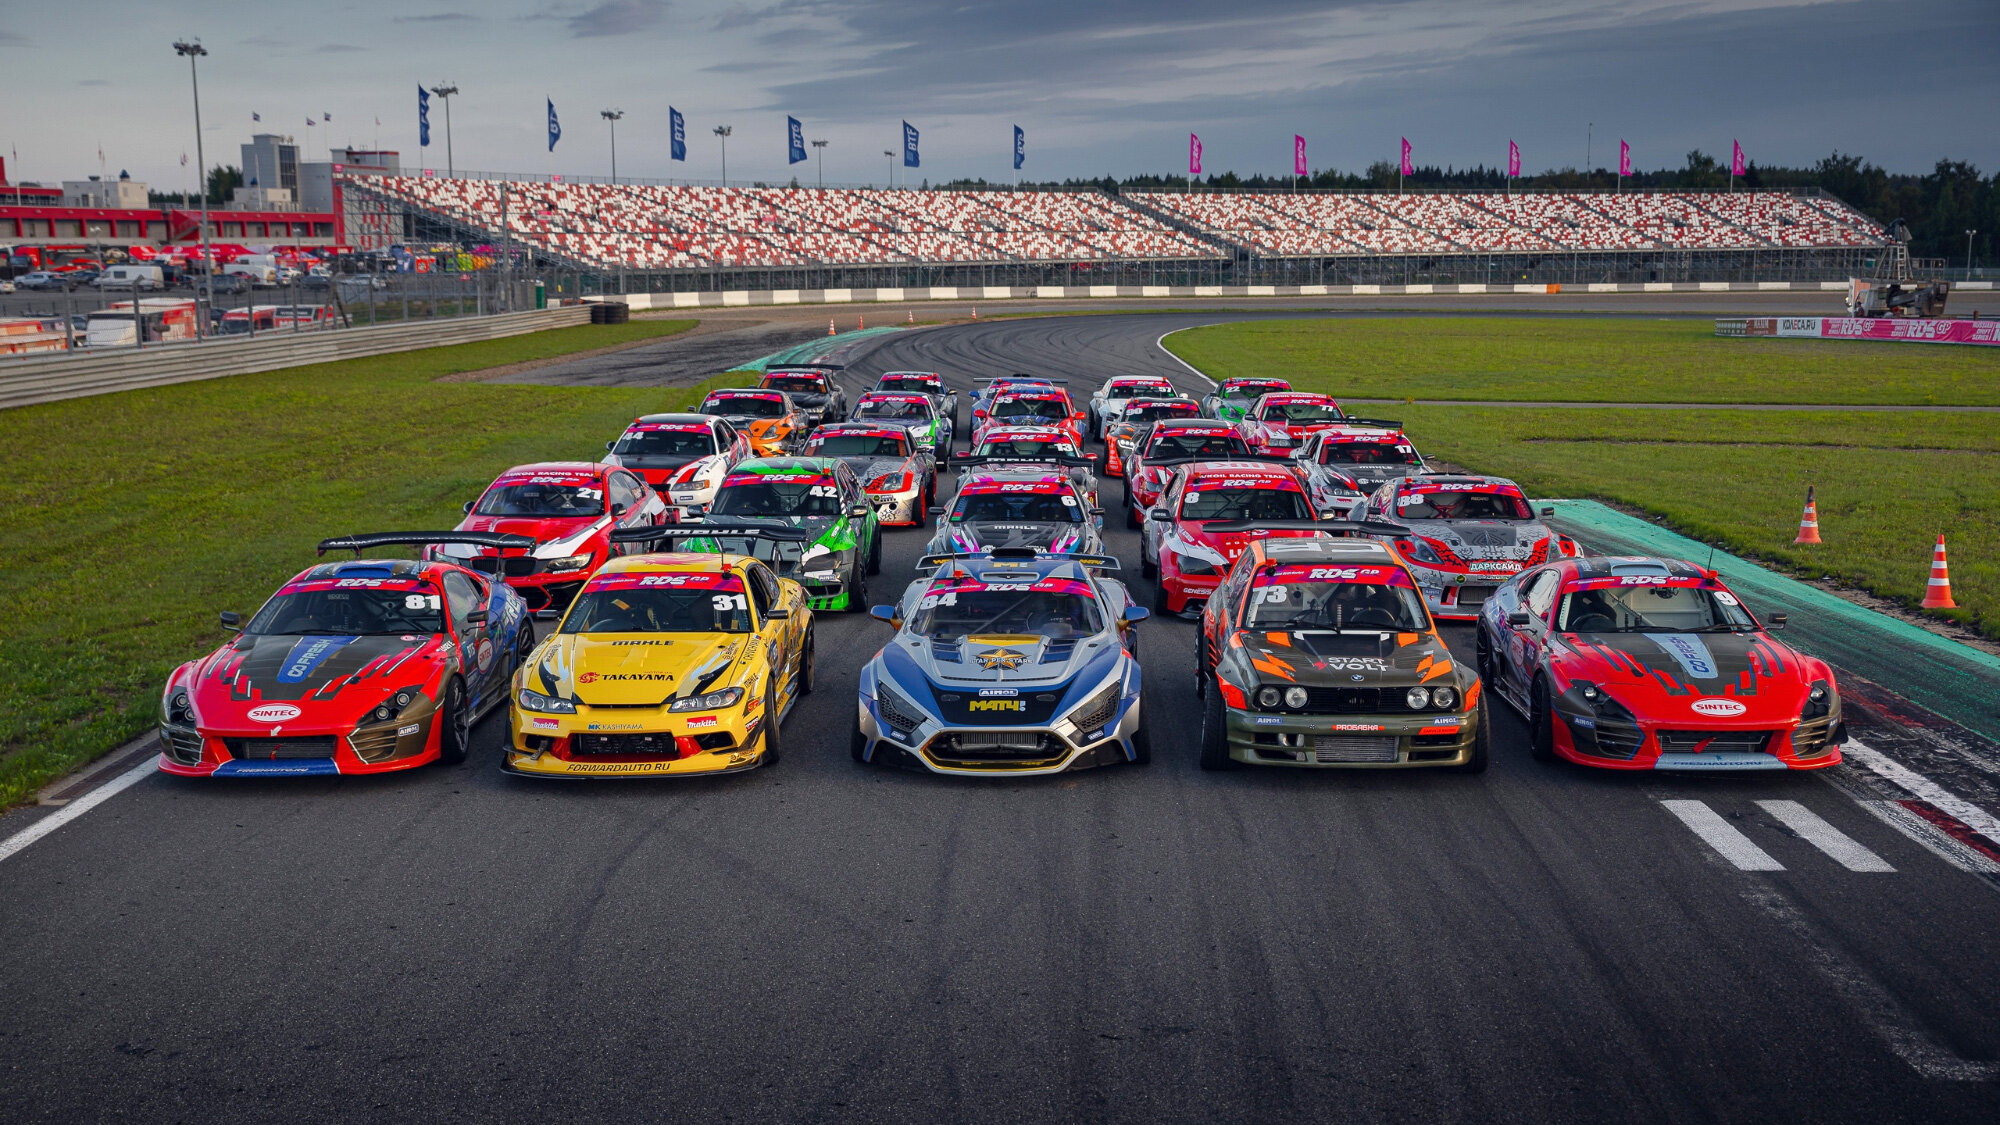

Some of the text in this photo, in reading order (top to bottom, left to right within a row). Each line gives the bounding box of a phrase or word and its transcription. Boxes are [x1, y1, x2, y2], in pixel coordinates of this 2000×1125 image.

[1840, 319, 1875, 335] RDS GP
[1907, 320, 1952, 338] RDS GP
[1222, 479, 1258, 487] RDS
[1440, 483, 1475, 491] RDS
[576, 487, 603, 501] 21
[809, 485, 838, 498] 42
[1184, 491, 1200, 504] 8
[1060, 495, 1078, 507] 6
[1397, 493, 1425, 507] 88
[1469, 561, 1524, 572] ДАРКСАЙД
[1308, 568, 1361, 580] RDS
[334, 578, 386, 587] RDS
[638, 575, 689, 586] RDS
[1620, 576, 1669, 585] RDS
[984, 583, 1031, 592] RDS
[920, 592, 957, 610] 84
[1252, 585, 1288, 605] 73
[1713, 591, 1739, 606] 9
[405, 594, 441, 610] 81
[711, 594, 748, 611] 31
[1327, 656, 1385, 664] START
[1329, 663, 1389, 672] VOLT
[602, 673, 675, 682] TAKAYAMA
[969, 700, 1026, 712] МАТЧ!
[1695, 702, 1743, 712] SINTEC
[252, 708, 298, 718] SINTEC
[566, 763, 671, 772] FORWARDAUTO RU
